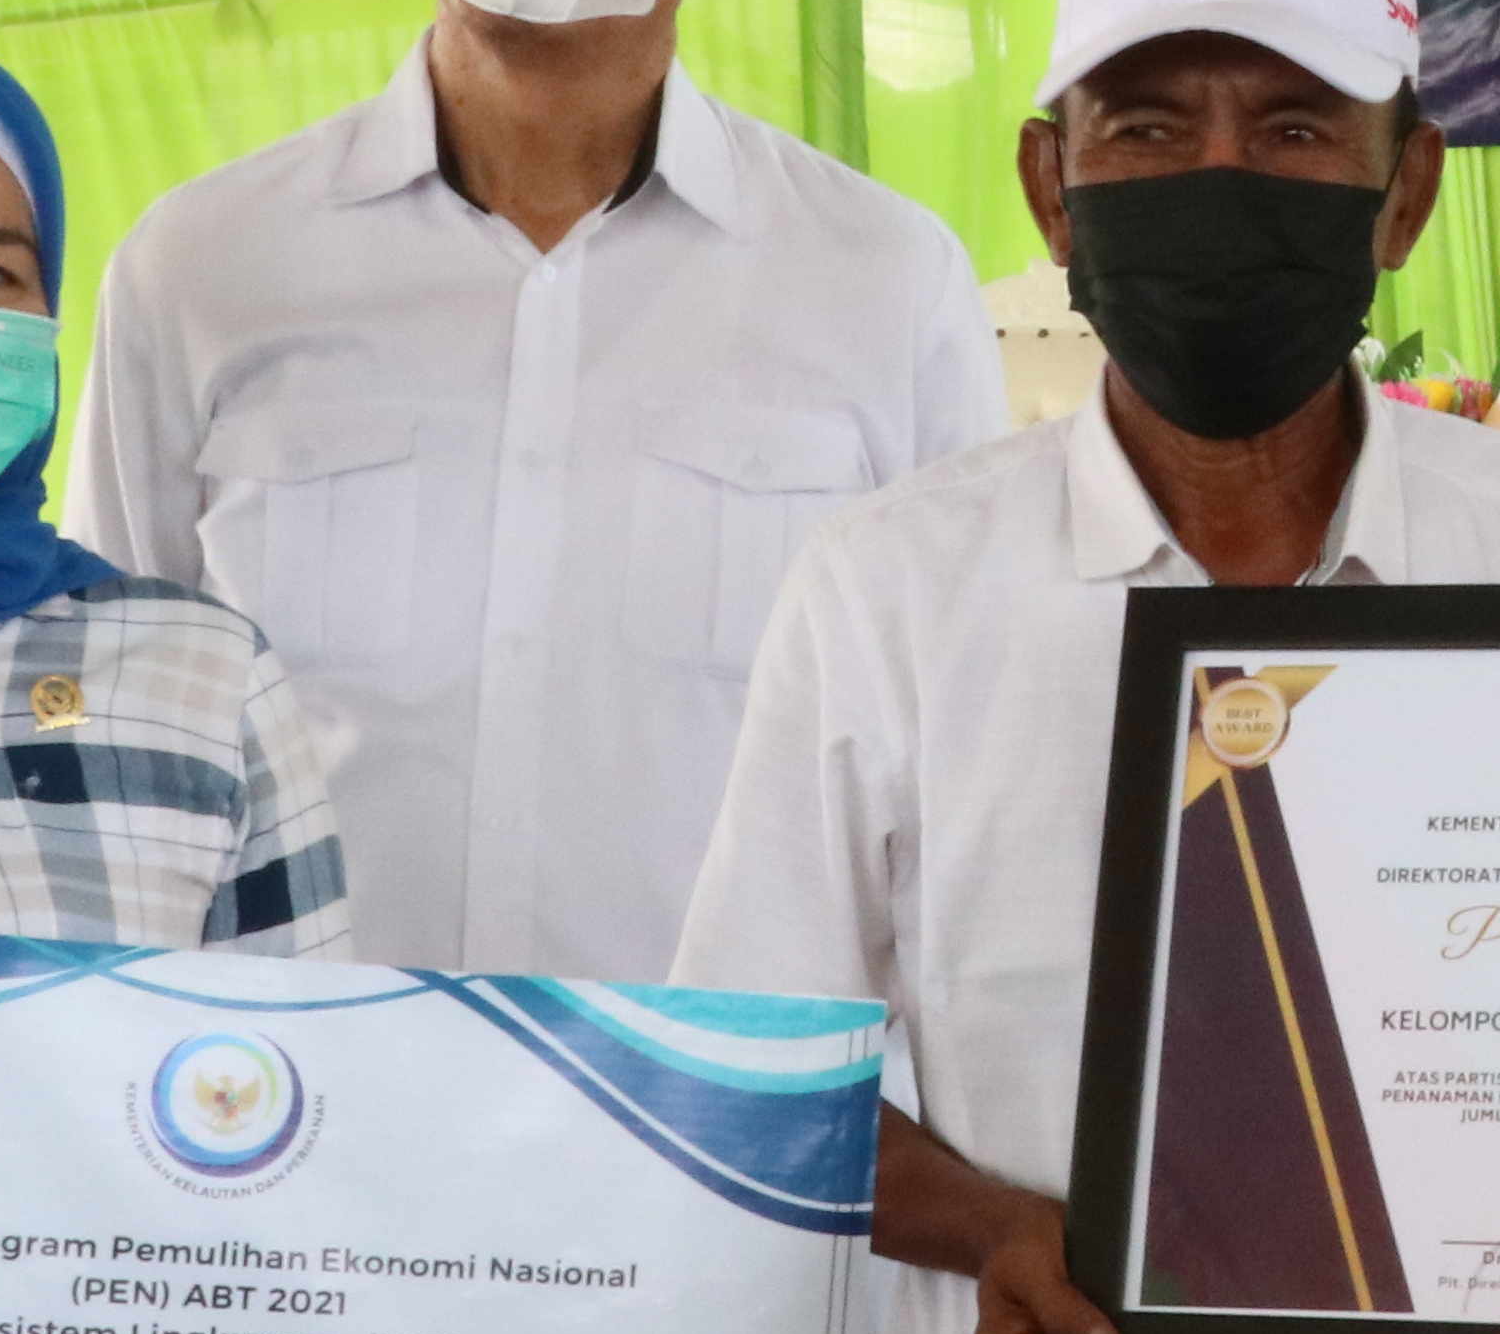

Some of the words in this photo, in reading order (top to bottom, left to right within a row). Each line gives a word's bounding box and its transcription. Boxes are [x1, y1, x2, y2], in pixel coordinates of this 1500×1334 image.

[1381, 1088, 1494, 1103] PENANAMAN
[1393, 1070, 1439, 1085] ATAS
[124, 1081, 173, 1181] KEMENTERIAN
[173, 1176, 253, 1200] KELAUTAN
[255, 1171, 286, 1194] DAN
[284, 1094, 326, 1175] PERIKANAN
[111, 1235, 306, 1270] Pemulihan
[321, 1247, 475, 1279] Ekonomi
[489, 1256, 636, 1287] Nasional
[71, 1275, 170, 1309] (PEN)
[182, 1283, 256, 1310] ABT
[267, 1287, 345, 1315] 2021
